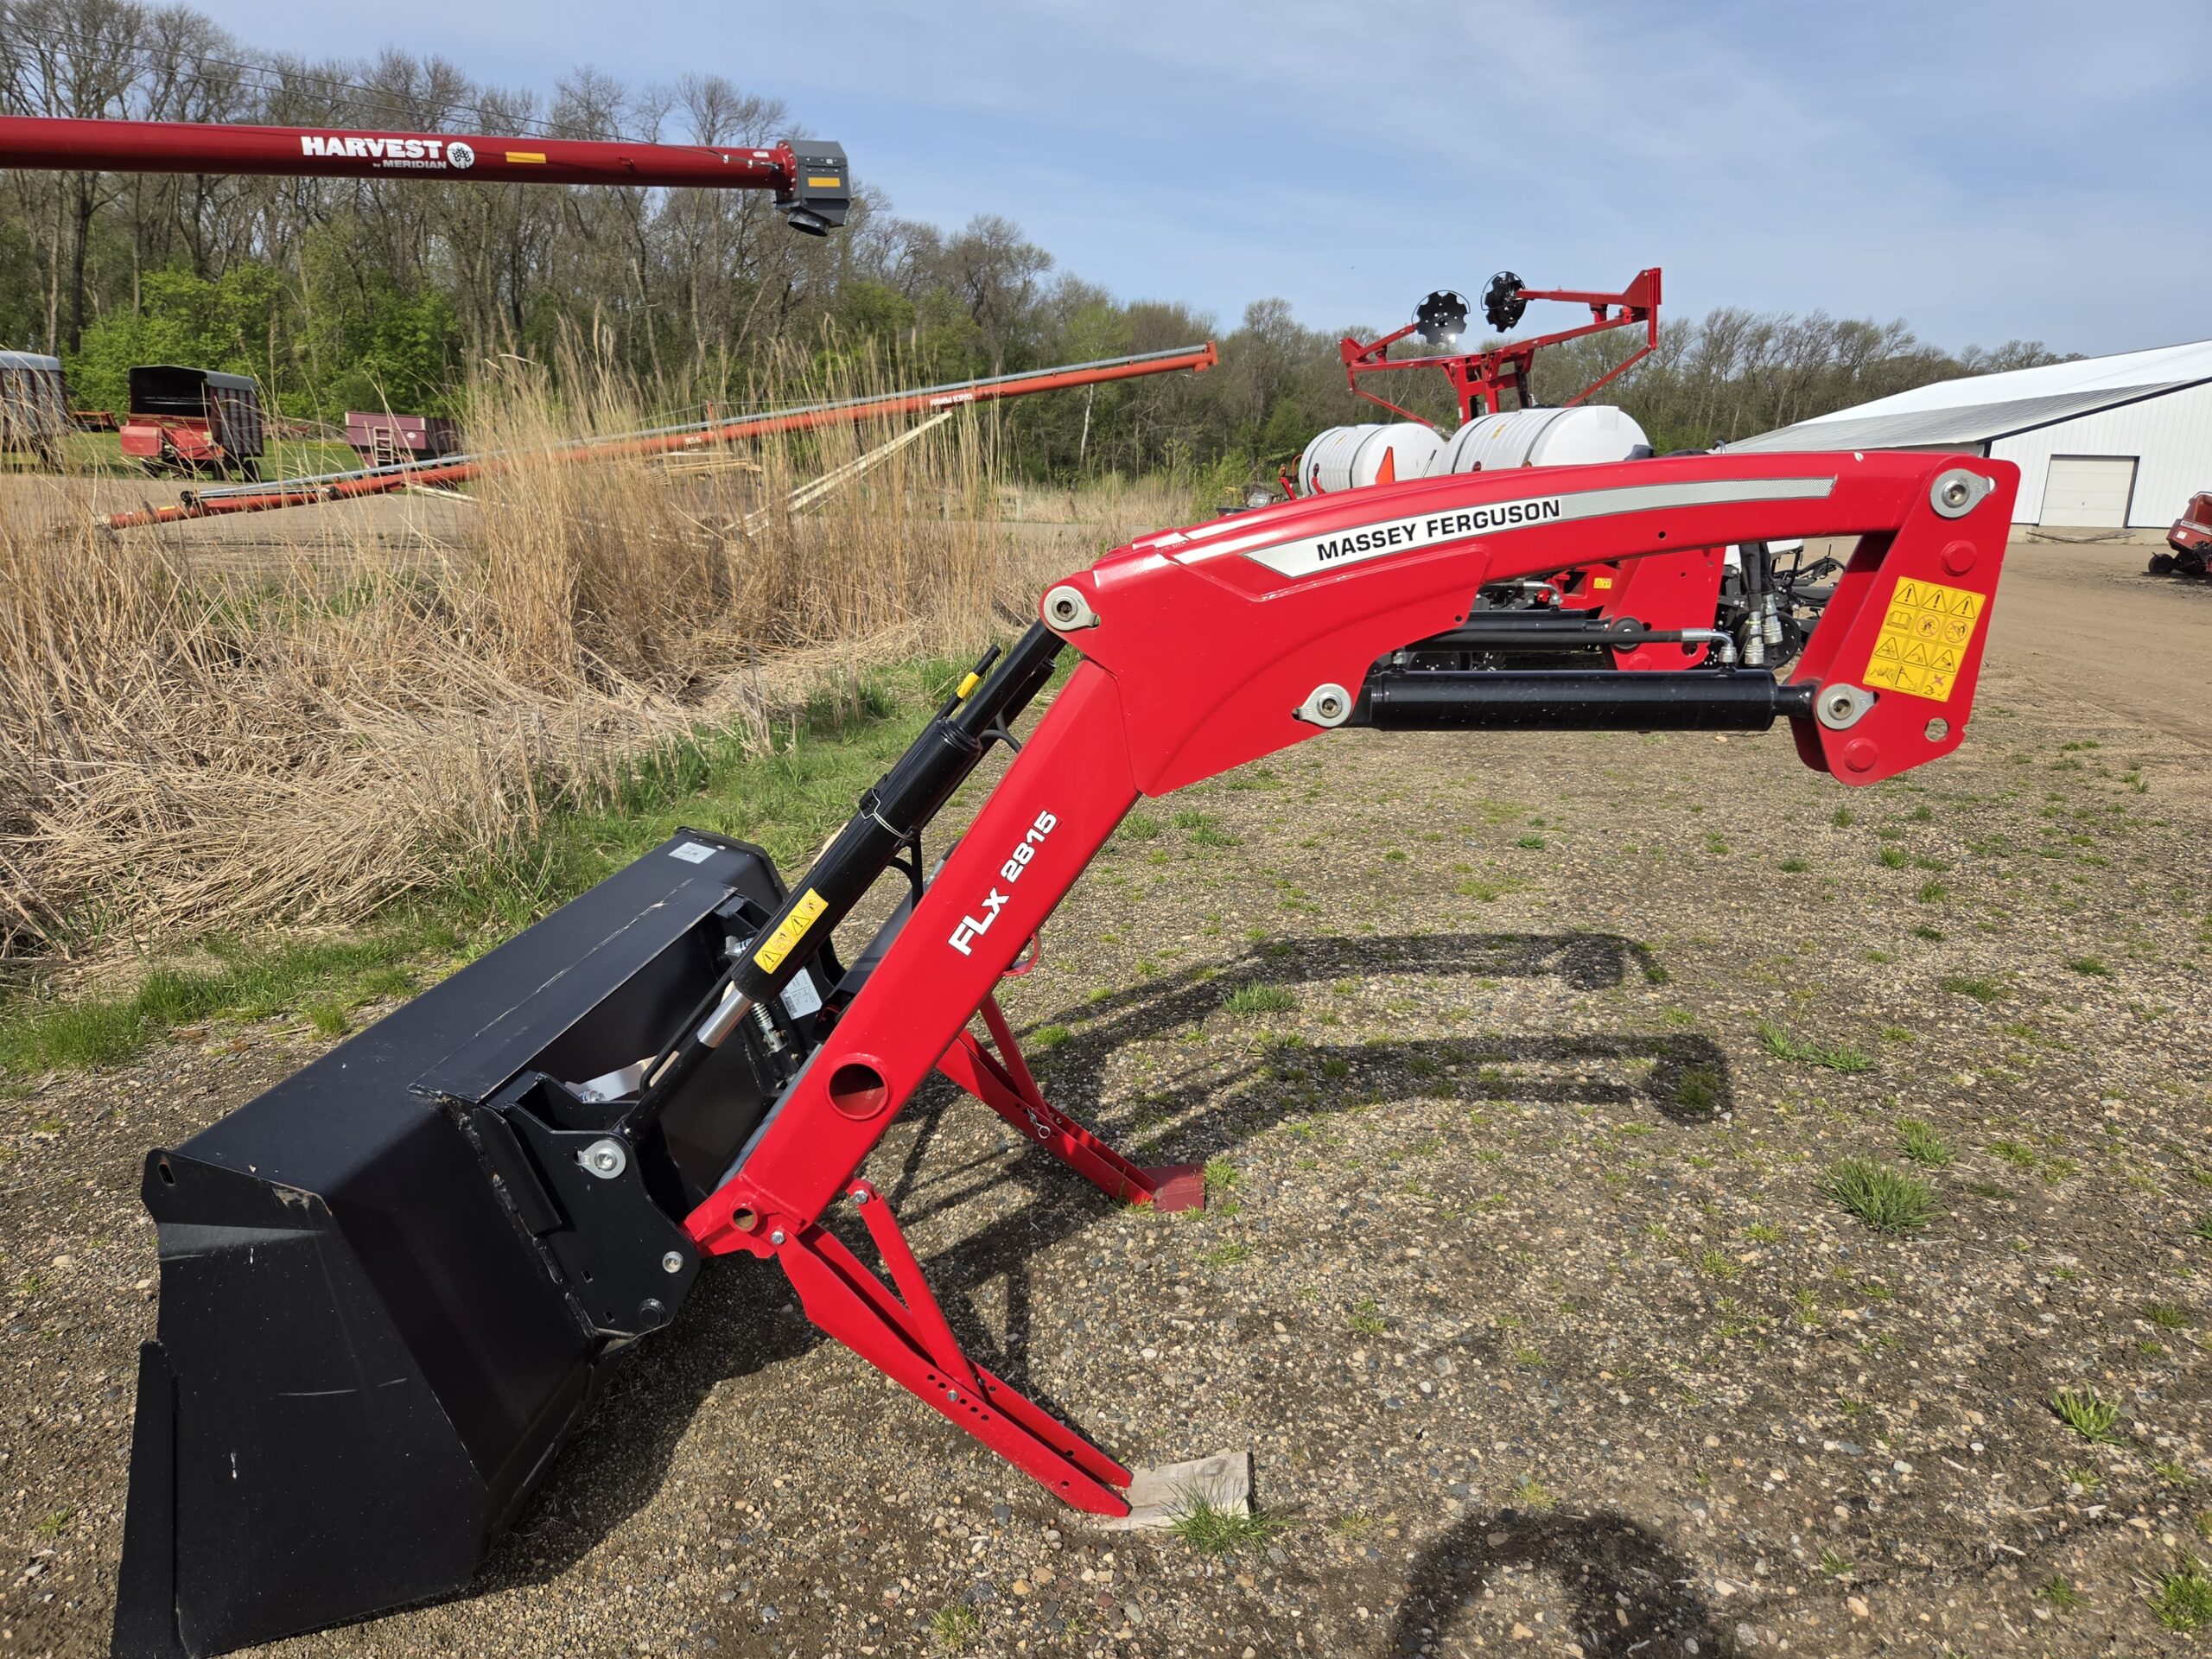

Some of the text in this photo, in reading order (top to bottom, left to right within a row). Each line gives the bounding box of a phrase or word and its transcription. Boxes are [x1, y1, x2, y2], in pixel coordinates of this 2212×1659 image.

[301, 136, 443, 159] HARVEST
[383, 160, 447, 169] MERIDIAN
[1316, 499, 1560, 561] MASSEY FERGUSON
[947, 810, 1058, 957] FLX 2815
